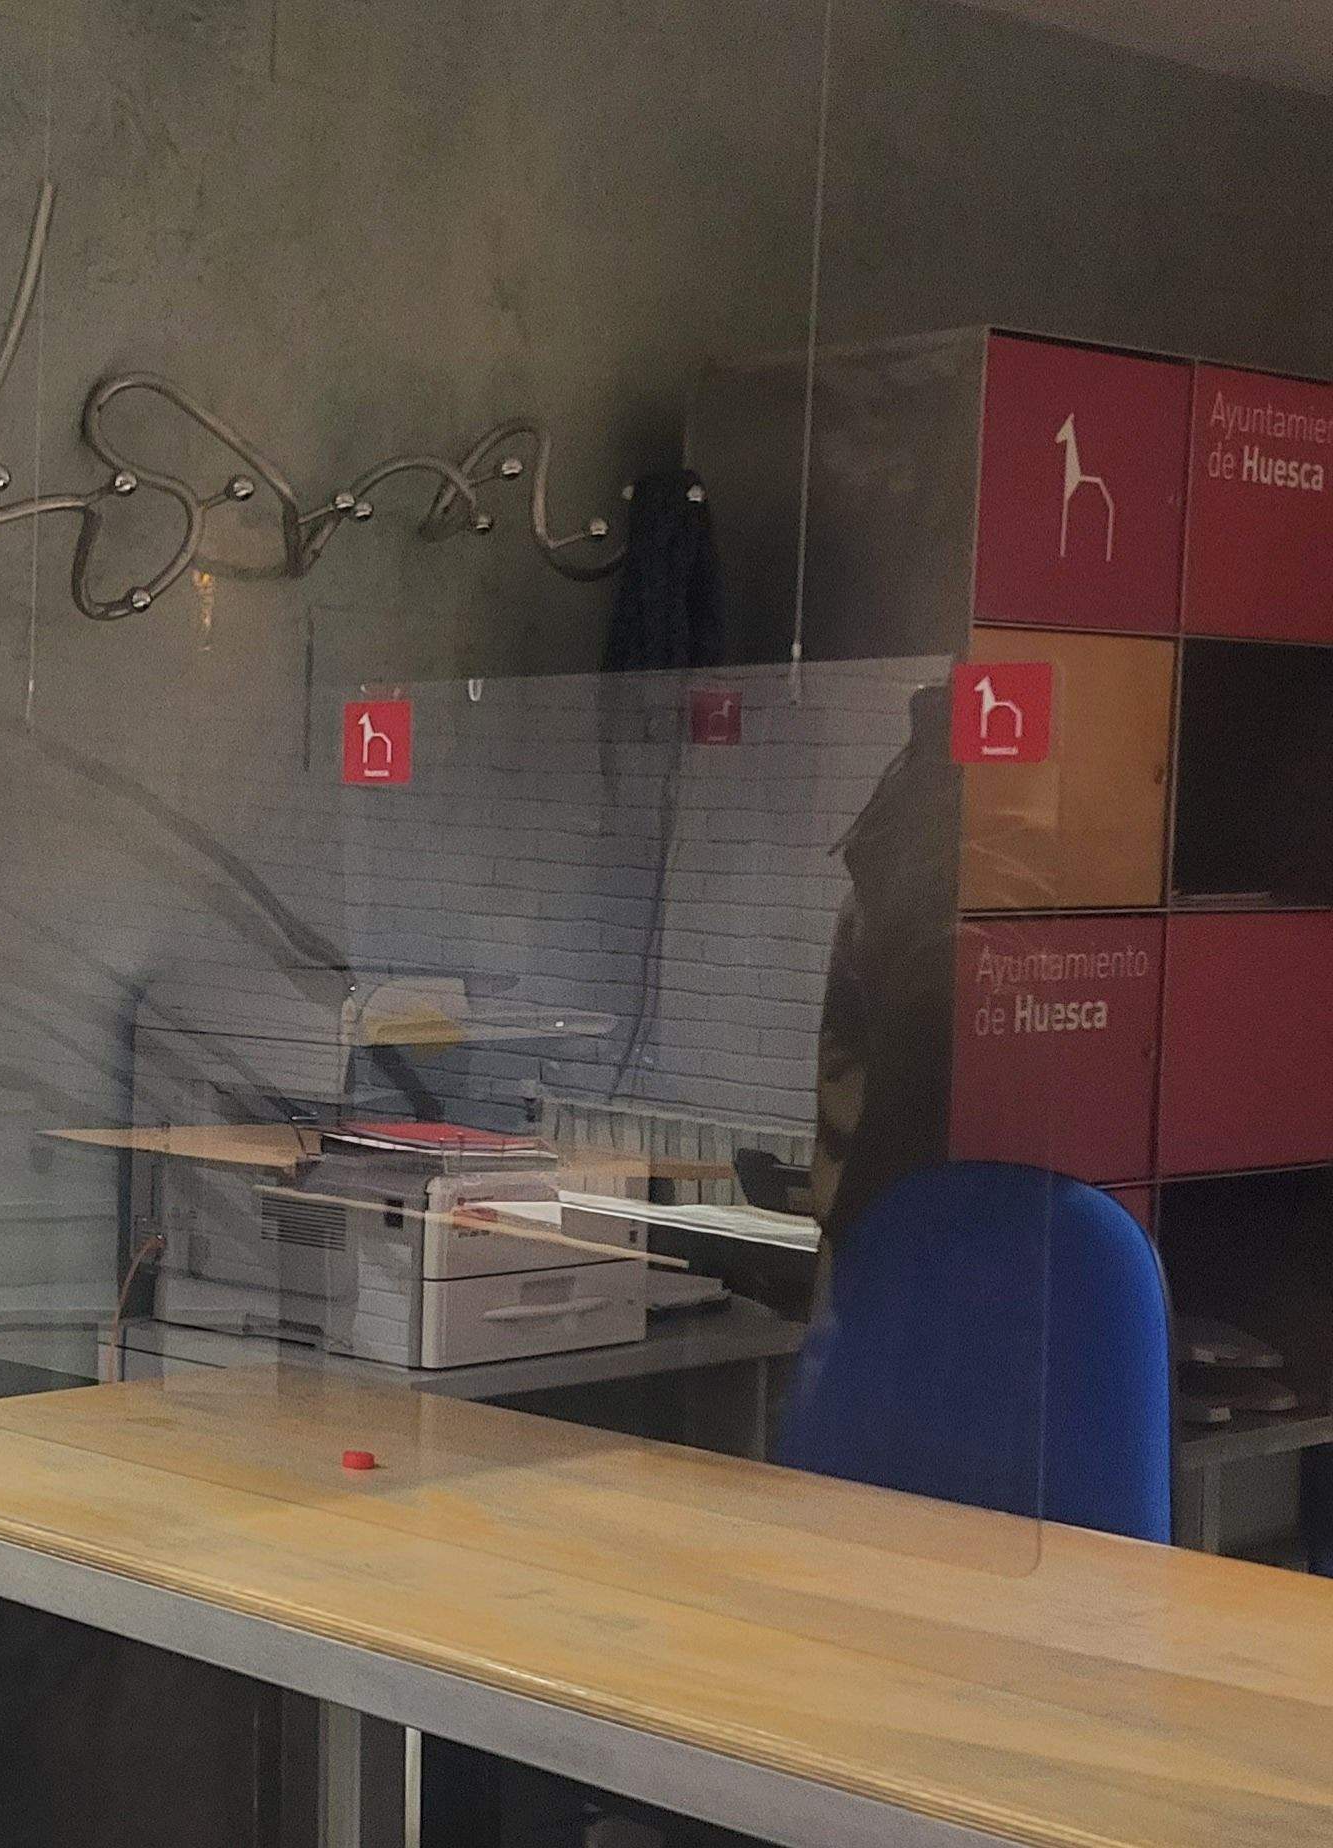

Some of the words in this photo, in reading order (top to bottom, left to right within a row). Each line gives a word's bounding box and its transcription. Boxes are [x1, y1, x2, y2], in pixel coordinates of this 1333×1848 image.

[1209, 441, 1234, 480] de
[1242, 445, 1325, 492] Huesca
[976, 946, 1149, 993] Ayuntamiento
[974, 998, 1006, 1036] de
[1013, 994, 1109, 1034] Huesca
